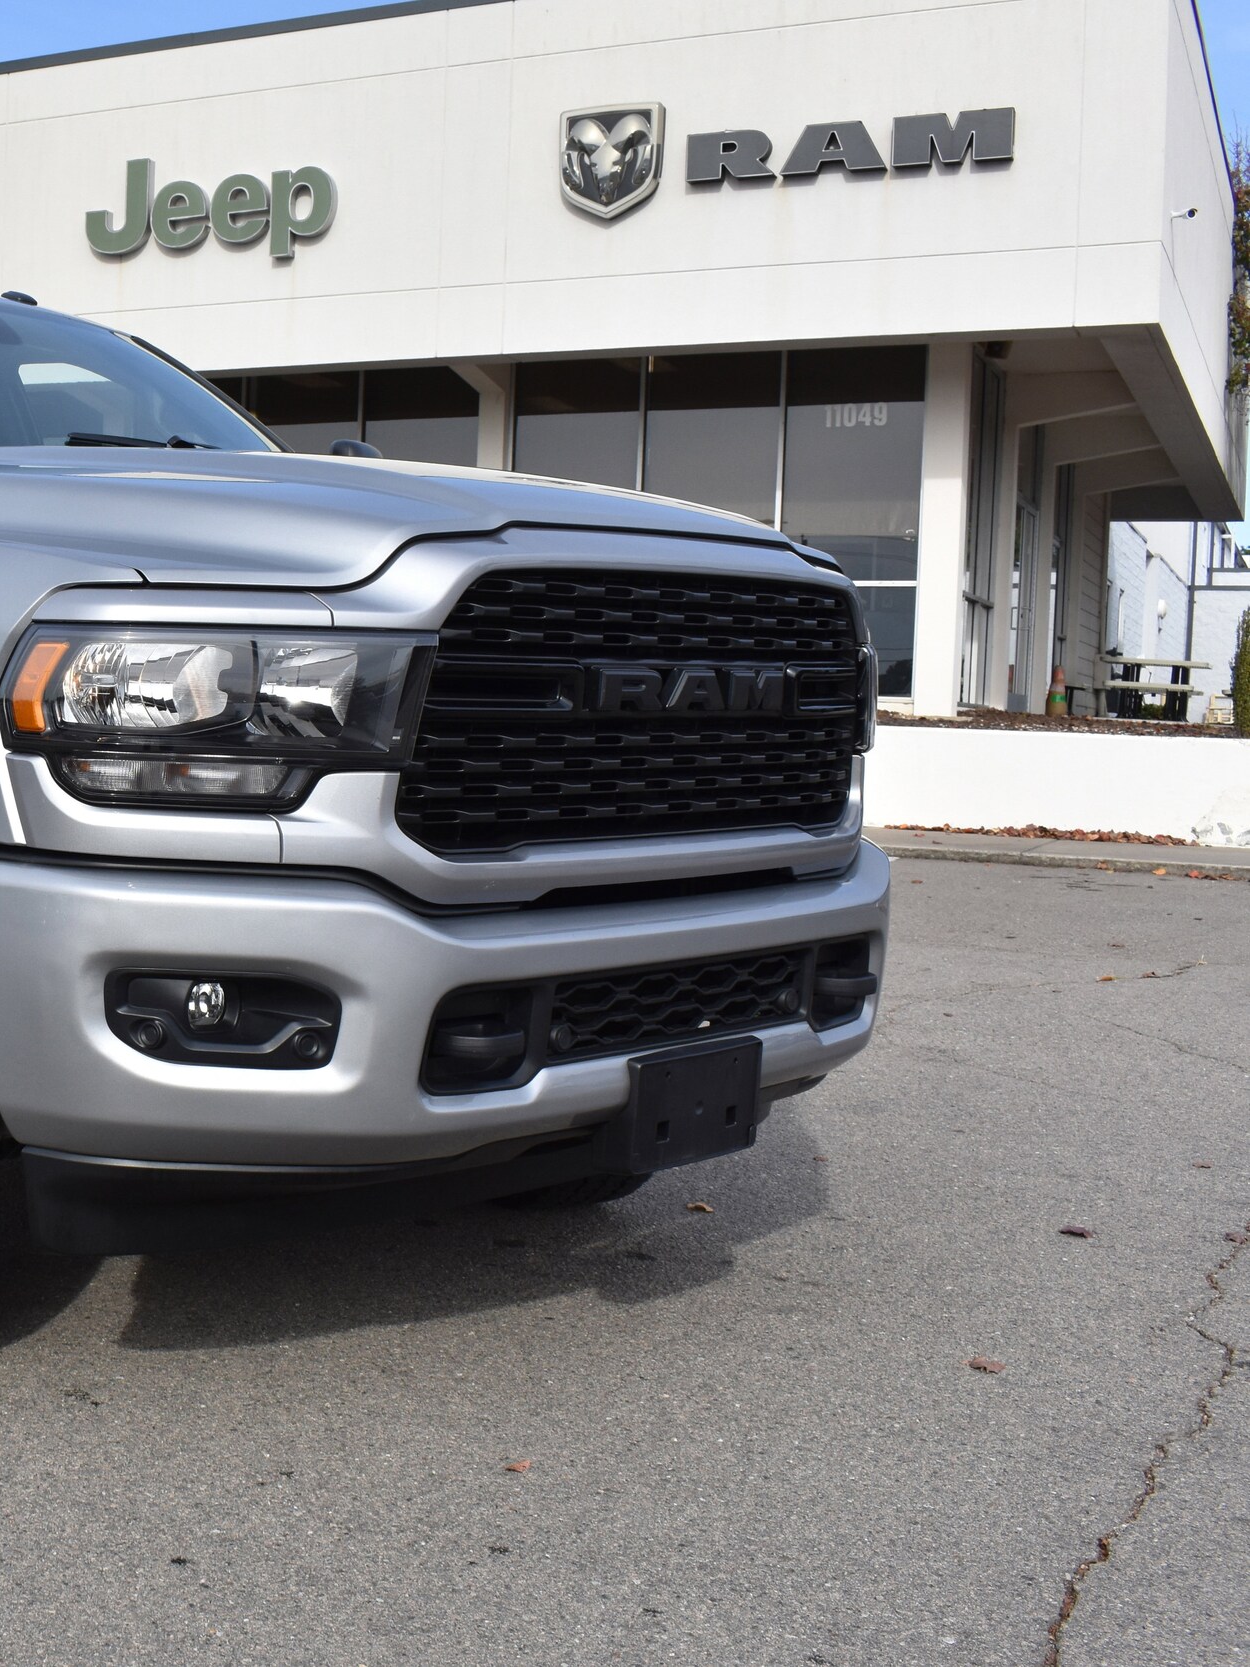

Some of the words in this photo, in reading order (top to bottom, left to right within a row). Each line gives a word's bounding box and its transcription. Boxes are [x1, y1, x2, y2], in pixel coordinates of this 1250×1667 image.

[685, 107, 1015, 187] RAM
[85, 158, 338, 260] Jeep
[824, 402, 887, 427] 11049
[598, 666, 784, 711] RAM
